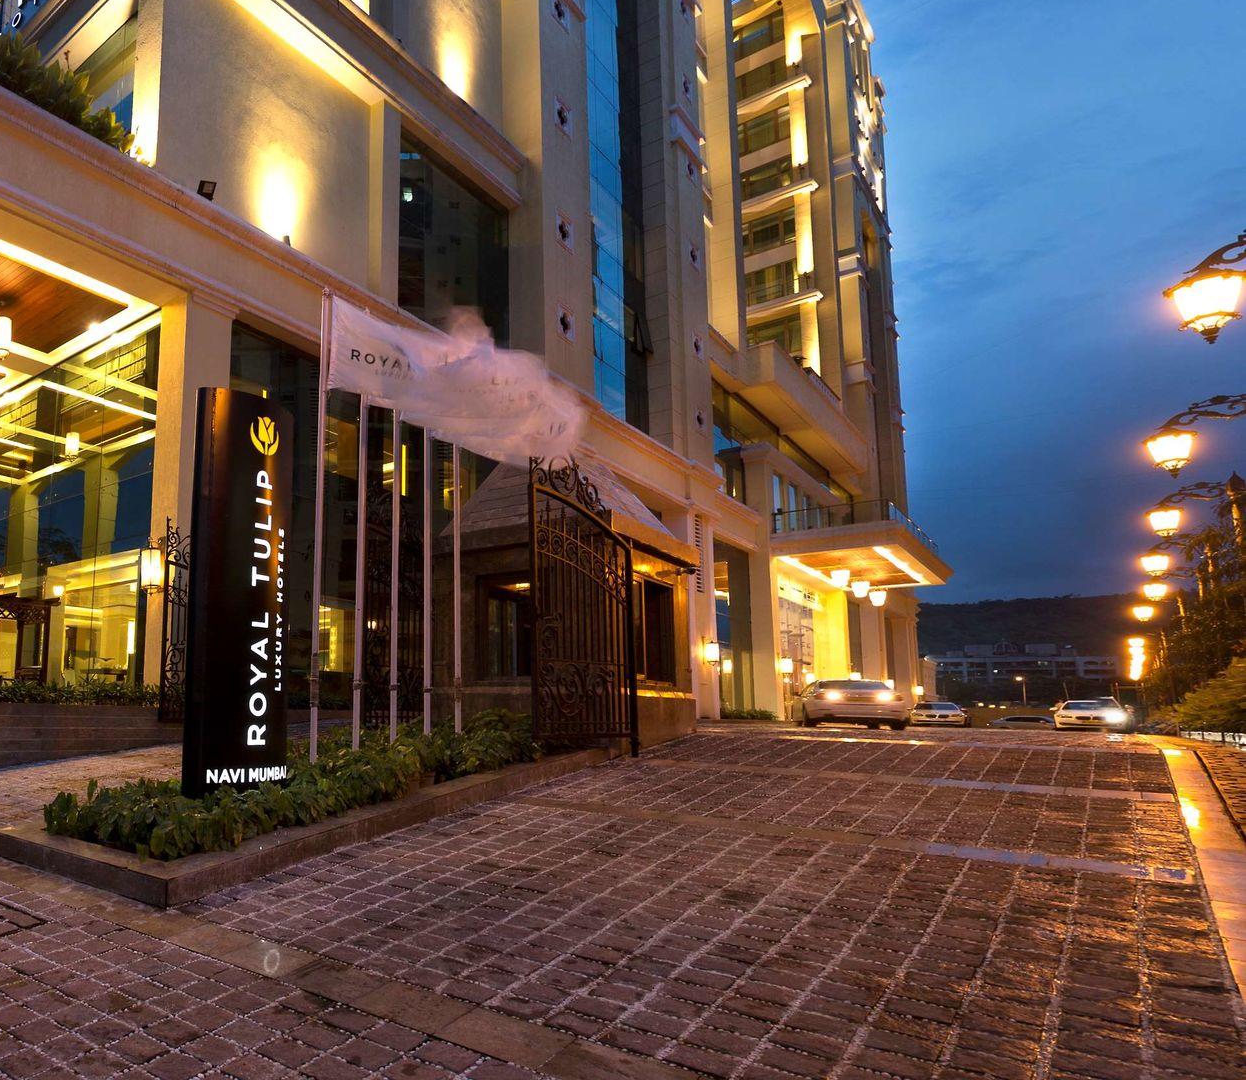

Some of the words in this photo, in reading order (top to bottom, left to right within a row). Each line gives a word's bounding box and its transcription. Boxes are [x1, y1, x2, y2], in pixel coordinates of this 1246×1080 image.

[251, 469, 273, 587] TULIP
[276, 528, 285, 603] HOTELS
[247, 611, 270, 746] ROYAL
[274, 612, 284, 692] LUXURY
[206, 768, 245, 784] NAVI
[248, 765, 287, 783] MUMBAI
